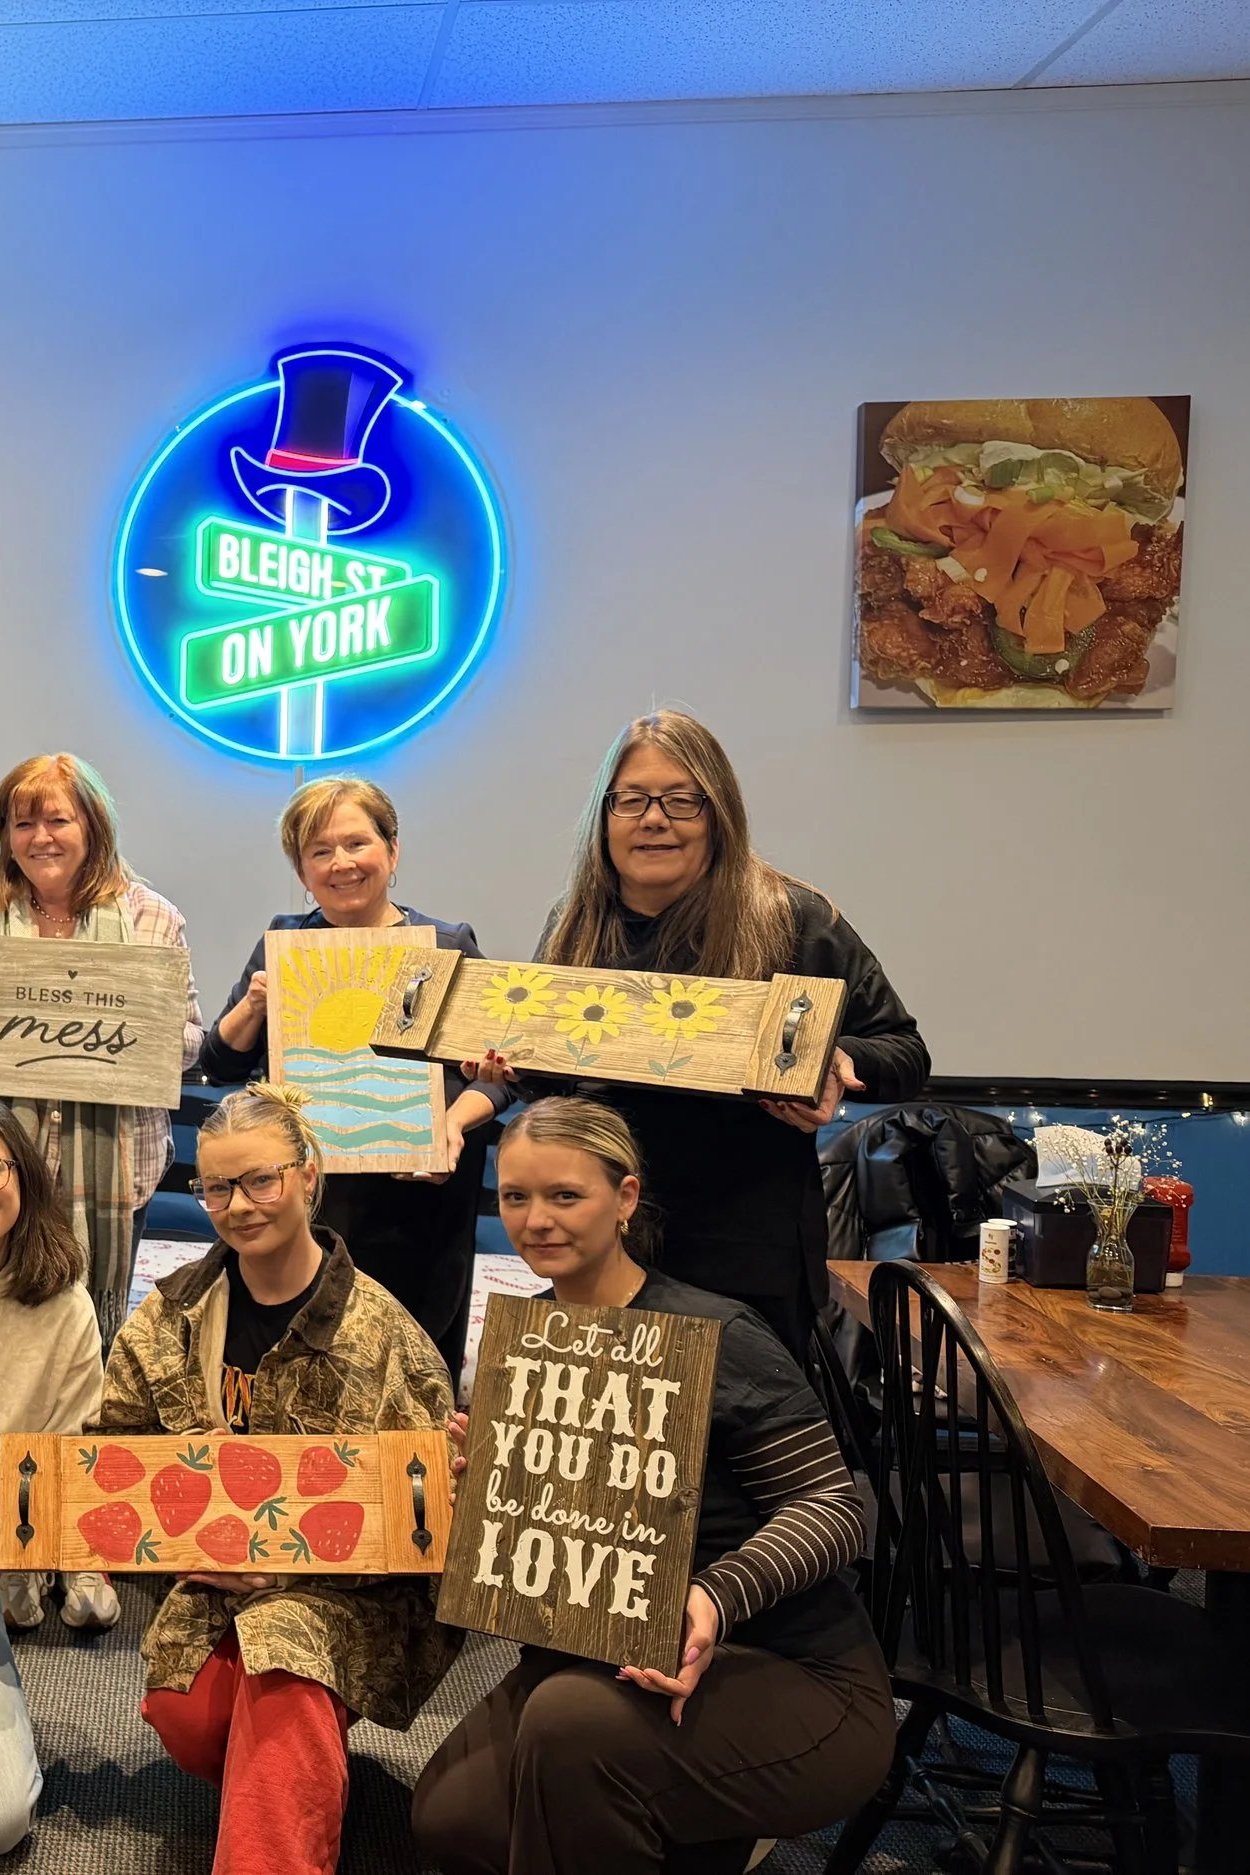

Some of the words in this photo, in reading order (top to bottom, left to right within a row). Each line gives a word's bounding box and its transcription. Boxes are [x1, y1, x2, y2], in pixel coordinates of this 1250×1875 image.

[218, 533, 333, 600] BLEIGH
[345, 560, 387, 595] ST
[221, 624, 274, 685] ON
[288, 595, 392, 668] YORK
[15, 986, 73, 1004] BLESS
[83, 991, 126, 1009] THIS
[520, 1310, 614, 1359] Let
[610, 1323, 664, 1368] all
[504, 1354, 682, 1443] THAT
[490, 1420, 594, 1482] YOU
[606, 1441, 678, 1499] DO
[485, 1468, 525, 1517] be
[530, 1482, 616, 1536] done
[621, 1510, 667, 1547] in
[472, 1519, 658, 1622] LOVE
